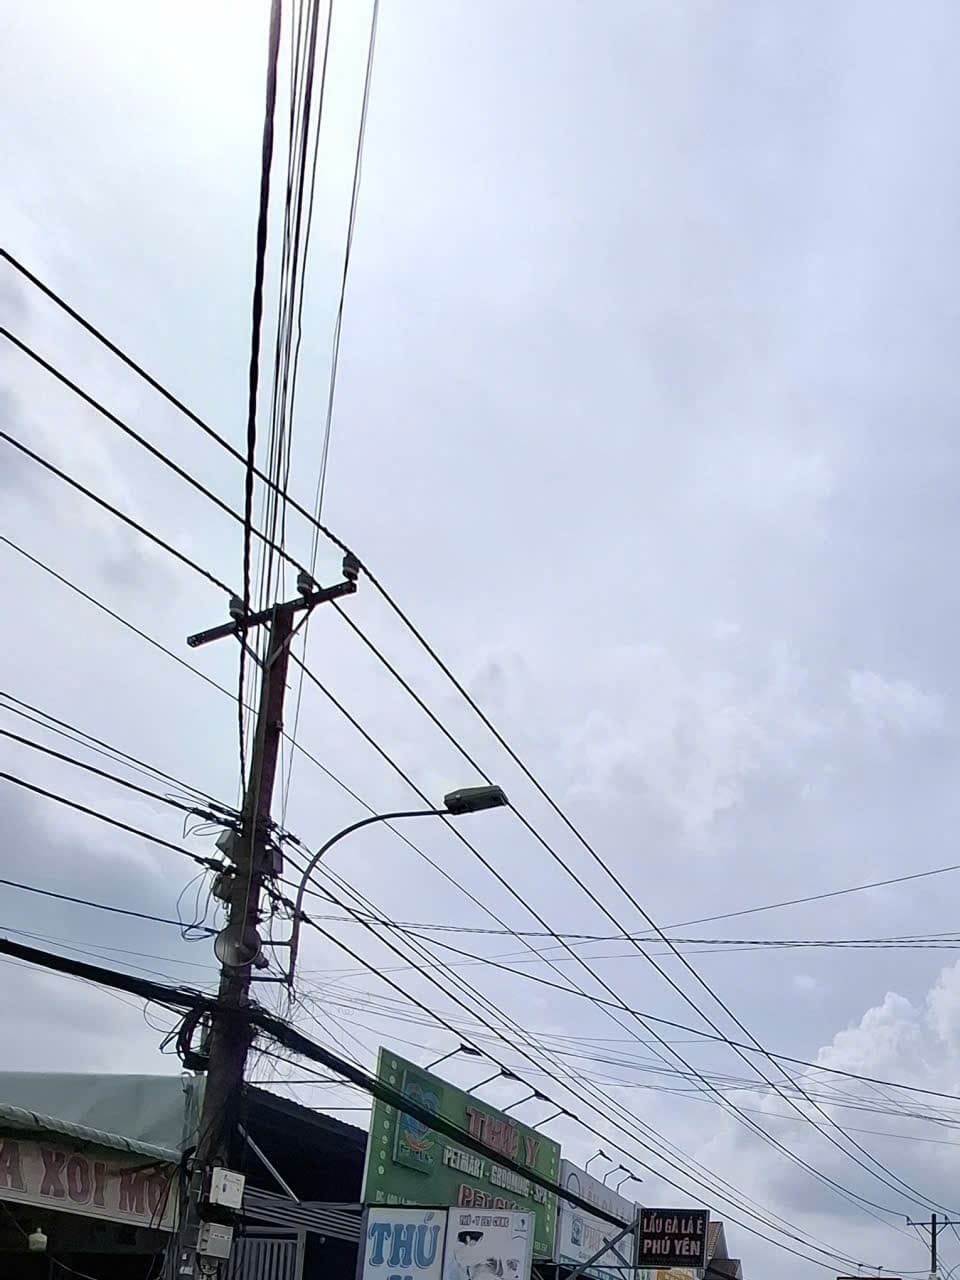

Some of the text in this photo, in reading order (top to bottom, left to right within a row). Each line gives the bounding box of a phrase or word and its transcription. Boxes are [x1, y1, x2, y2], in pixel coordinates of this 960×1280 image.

[665, 1215, 680, 1234] GÀ
[368, 1212, 441, 1270] THÚ
[643, 1235, 701, 1256] PHÚ YÊN
